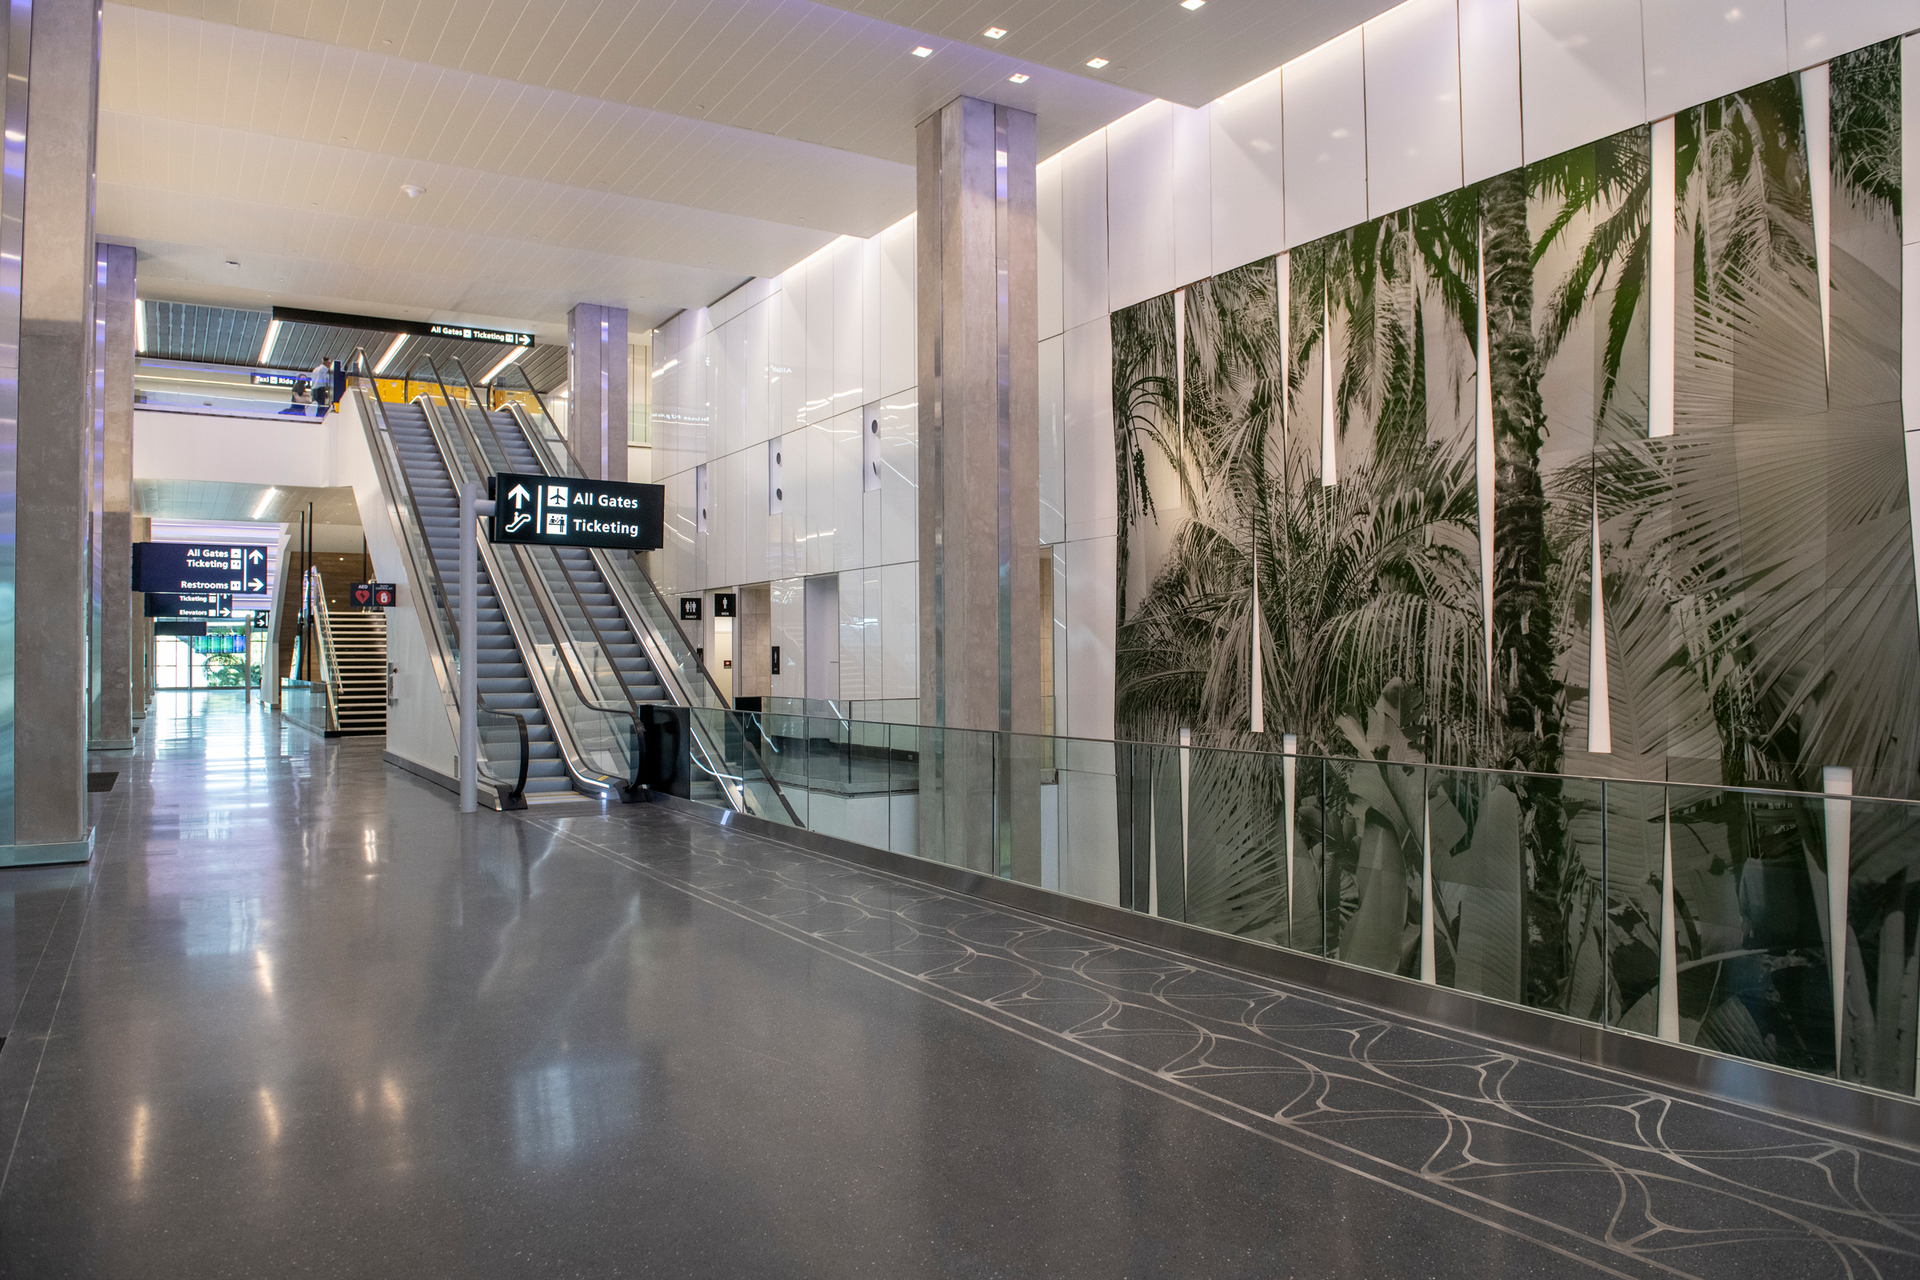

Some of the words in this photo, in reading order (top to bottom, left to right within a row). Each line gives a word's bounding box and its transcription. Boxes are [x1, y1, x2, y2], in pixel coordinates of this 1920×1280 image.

[430, 326, 441, 334] All
[442, 327, 462, 336] Gates
[473, 331, 505, 342] Ticketing
[254, 375, 269, 384] Taxi
[278, 377, 293, 385] Ride
[572, 492, 594, 506] All
[598, 494, 639, 509] Gates
[573, 518, 639, 538] Ticketing
[186, 549, 201, 557] All
[202, 549, 229, 558] Gates
[186, 559, 229, 570] Ticketing
[180, 580, 229, 590] Restrooms
[179, 595, 208, 603] Ticketing
